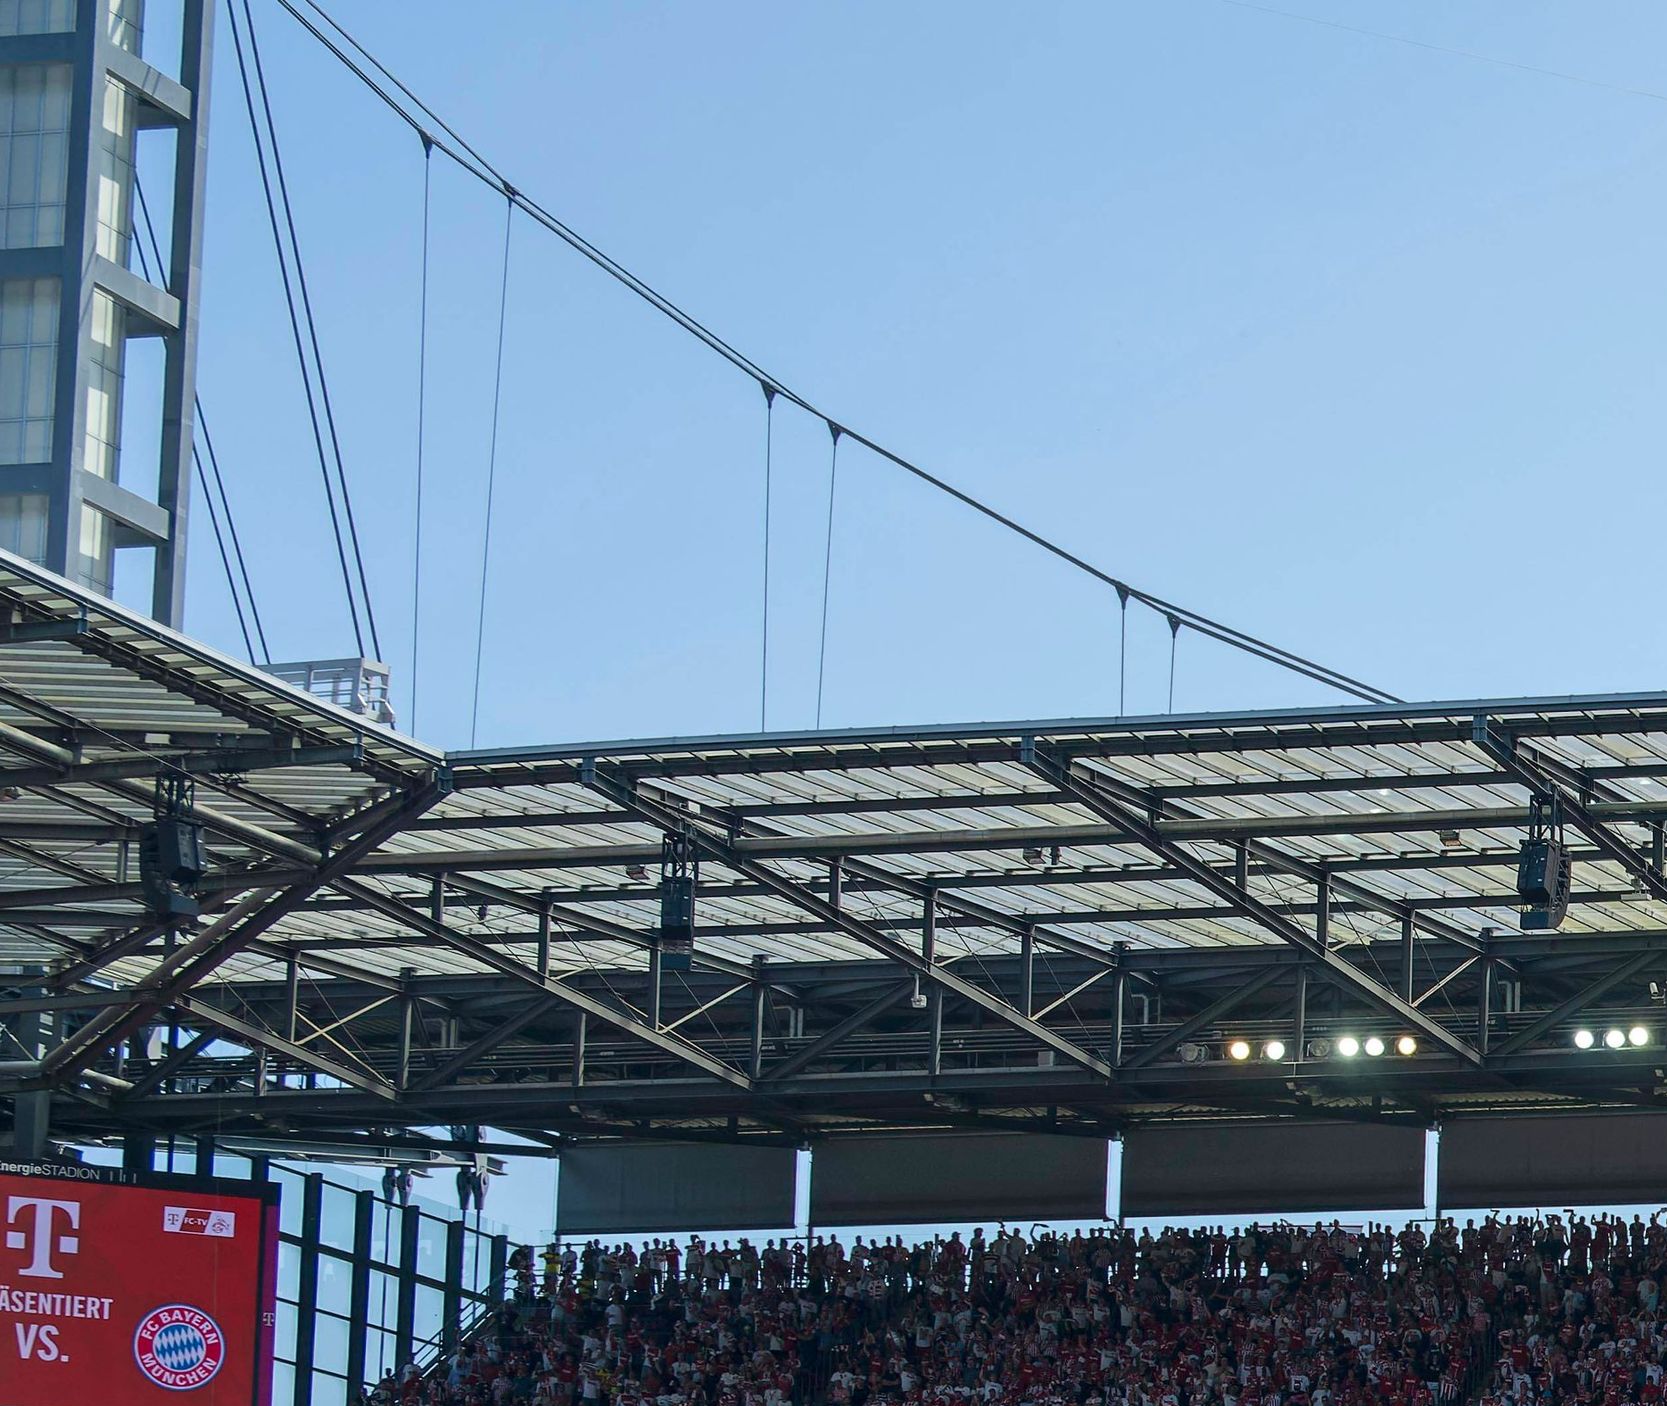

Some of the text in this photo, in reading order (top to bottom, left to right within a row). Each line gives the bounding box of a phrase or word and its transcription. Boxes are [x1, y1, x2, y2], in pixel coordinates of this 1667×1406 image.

[0, 1160, 100, 1180] nergieSTADION
[15, 1322, 70, 1363] VS.
[162, 1309, 218, 1345] BAYERN
[141, 1352, 217, 1386] MÜNCHEN
